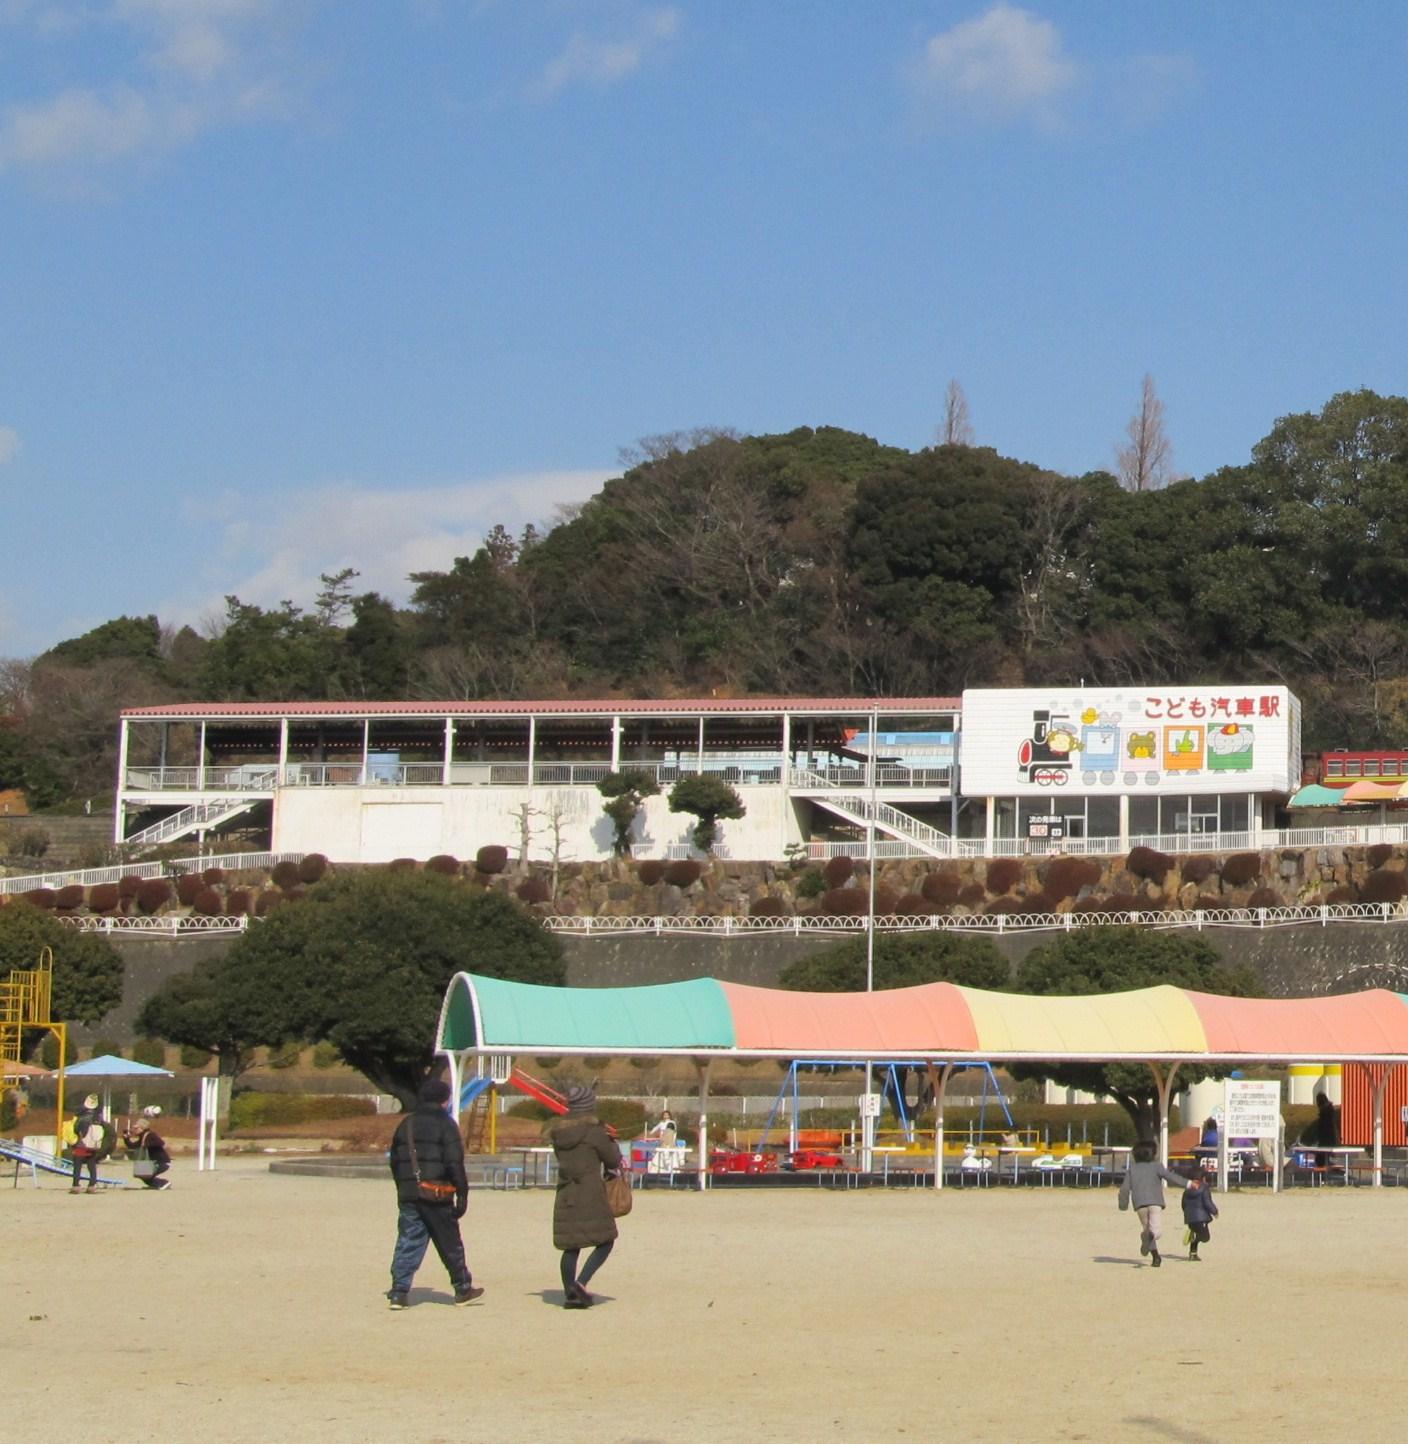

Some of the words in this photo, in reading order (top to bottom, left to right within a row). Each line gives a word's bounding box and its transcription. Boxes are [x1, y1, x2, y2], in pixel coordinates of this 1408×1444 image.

[1145, 695, 1280, 719] こども汽車駅
